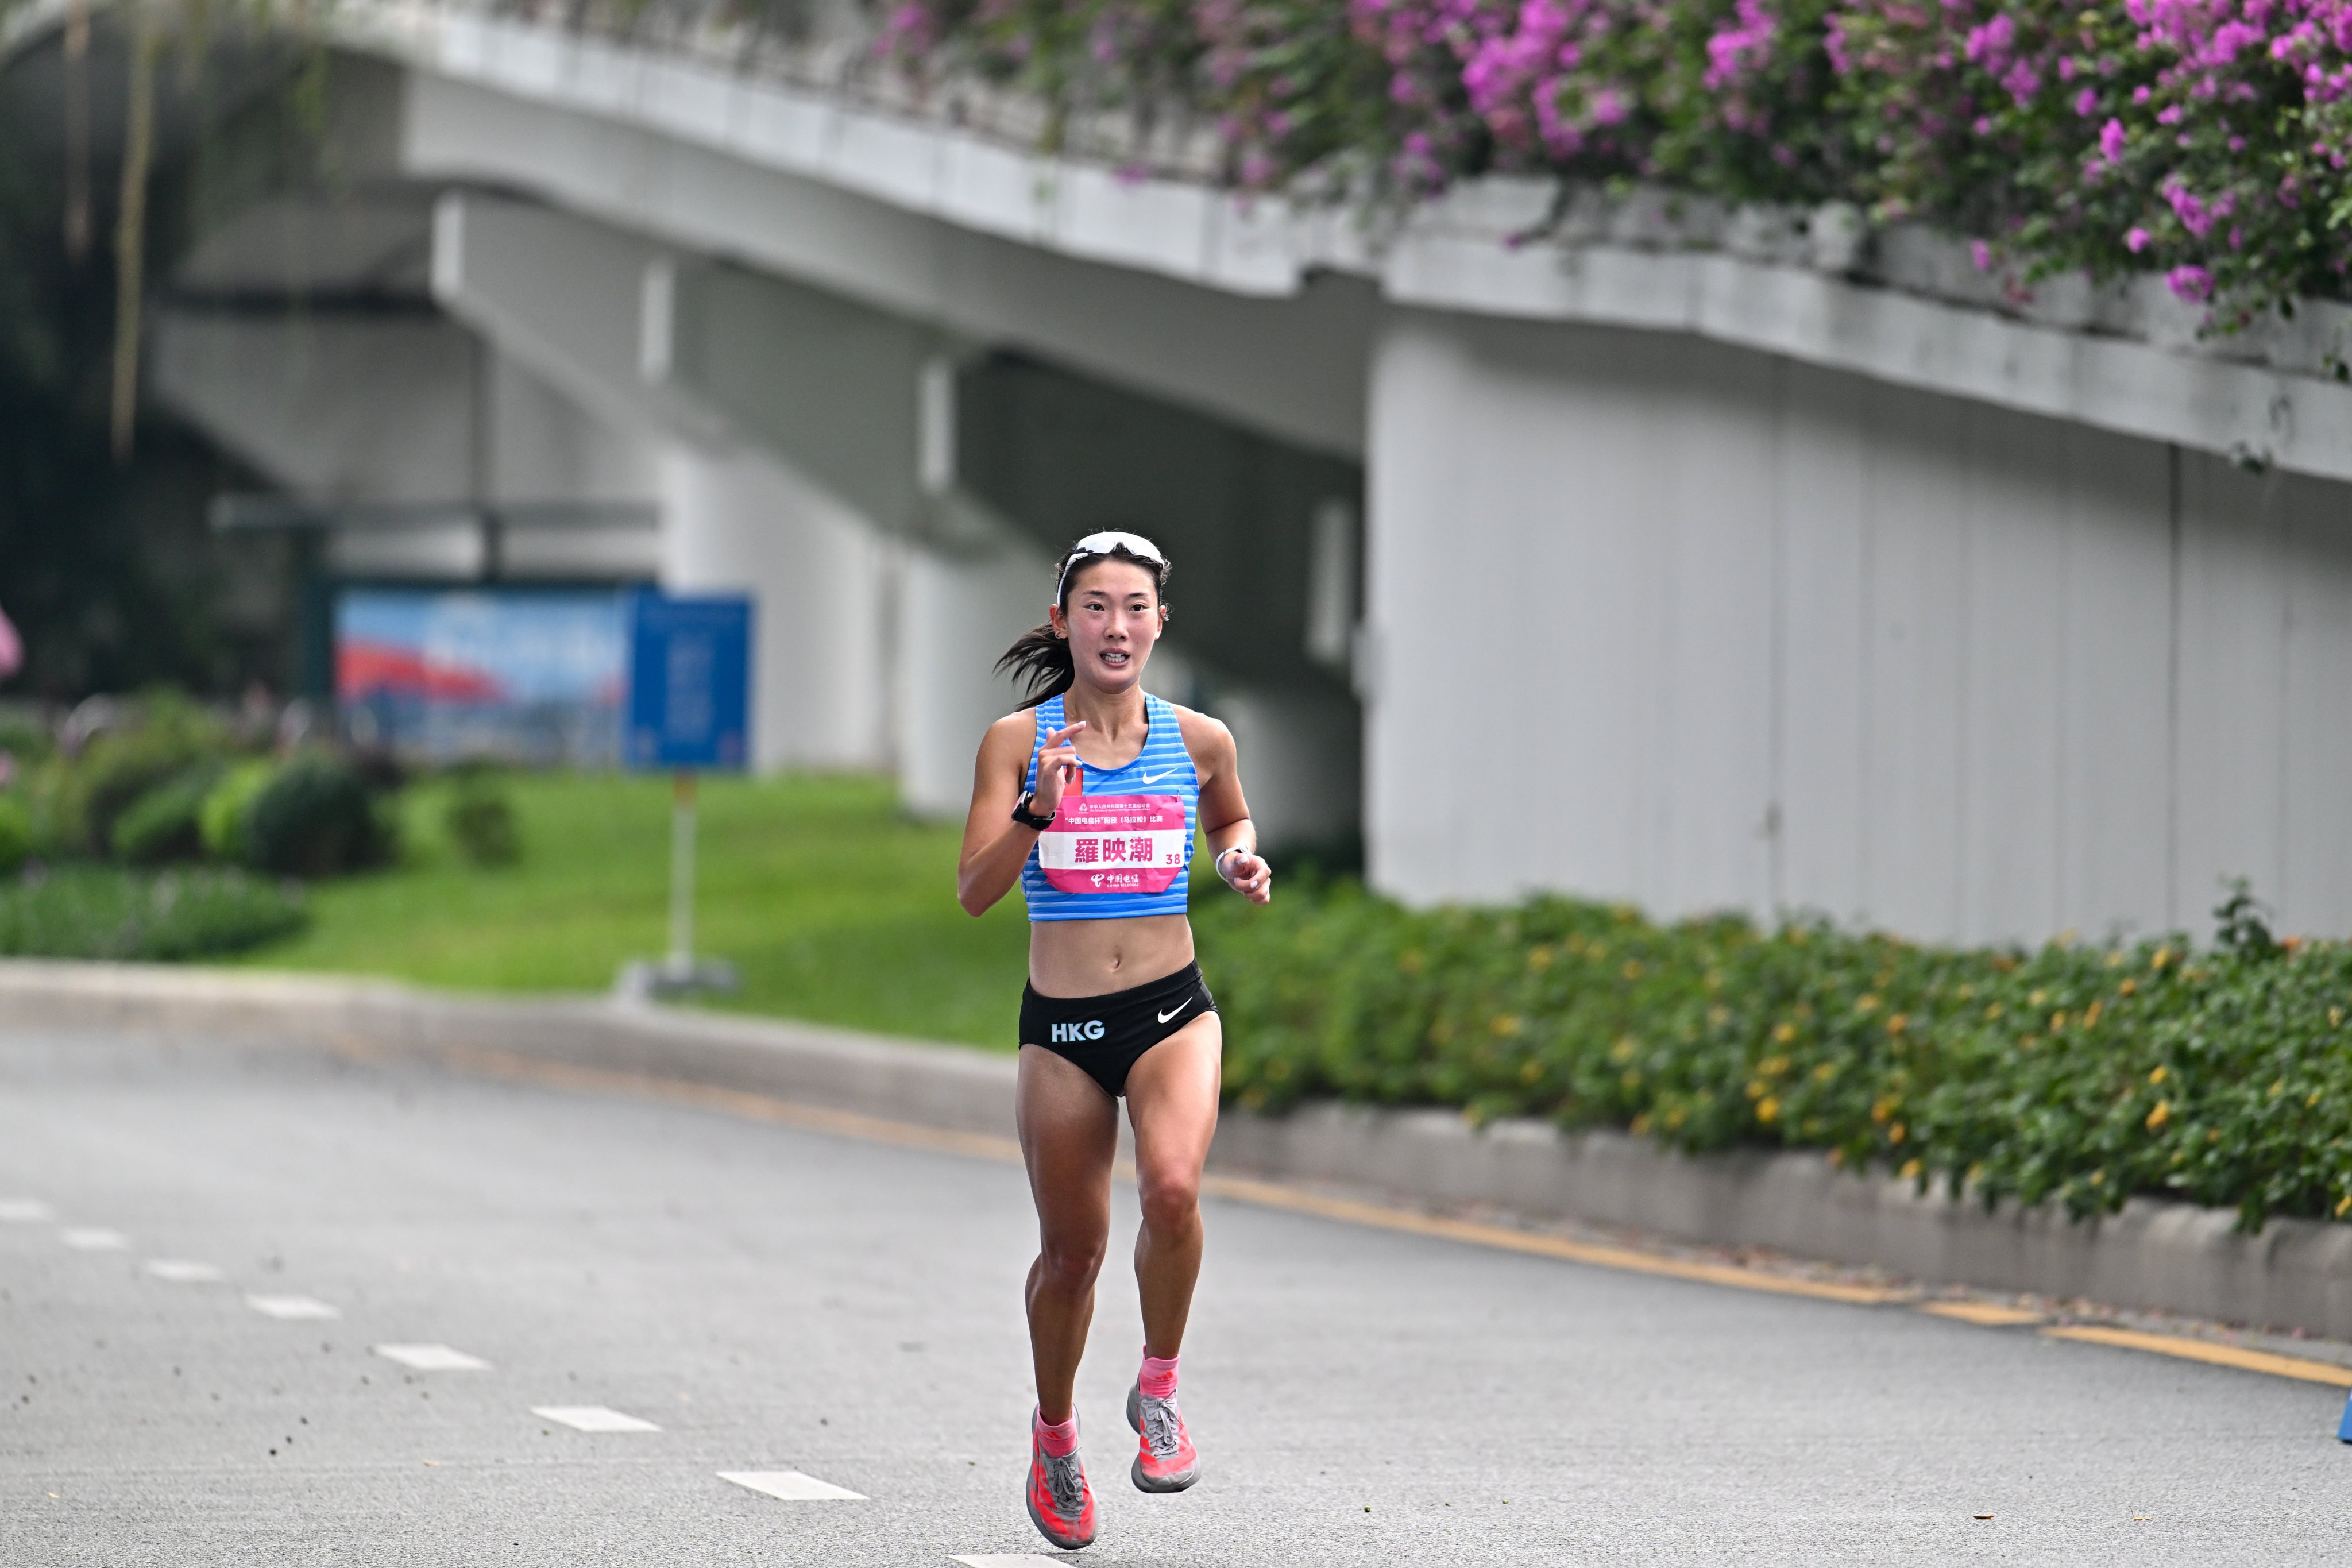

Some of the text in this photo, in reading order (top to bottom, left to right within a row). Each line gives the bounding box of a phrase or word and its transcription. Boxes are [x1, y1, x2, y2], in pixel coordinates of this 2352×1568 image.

[1075, 837, 1153, 863] 羅映潮
[1165, 853, 1180, 865] 38
[1107, 874, 1139, 884] 中国电信
[1051, 1019, 1105, 1042] HKG
